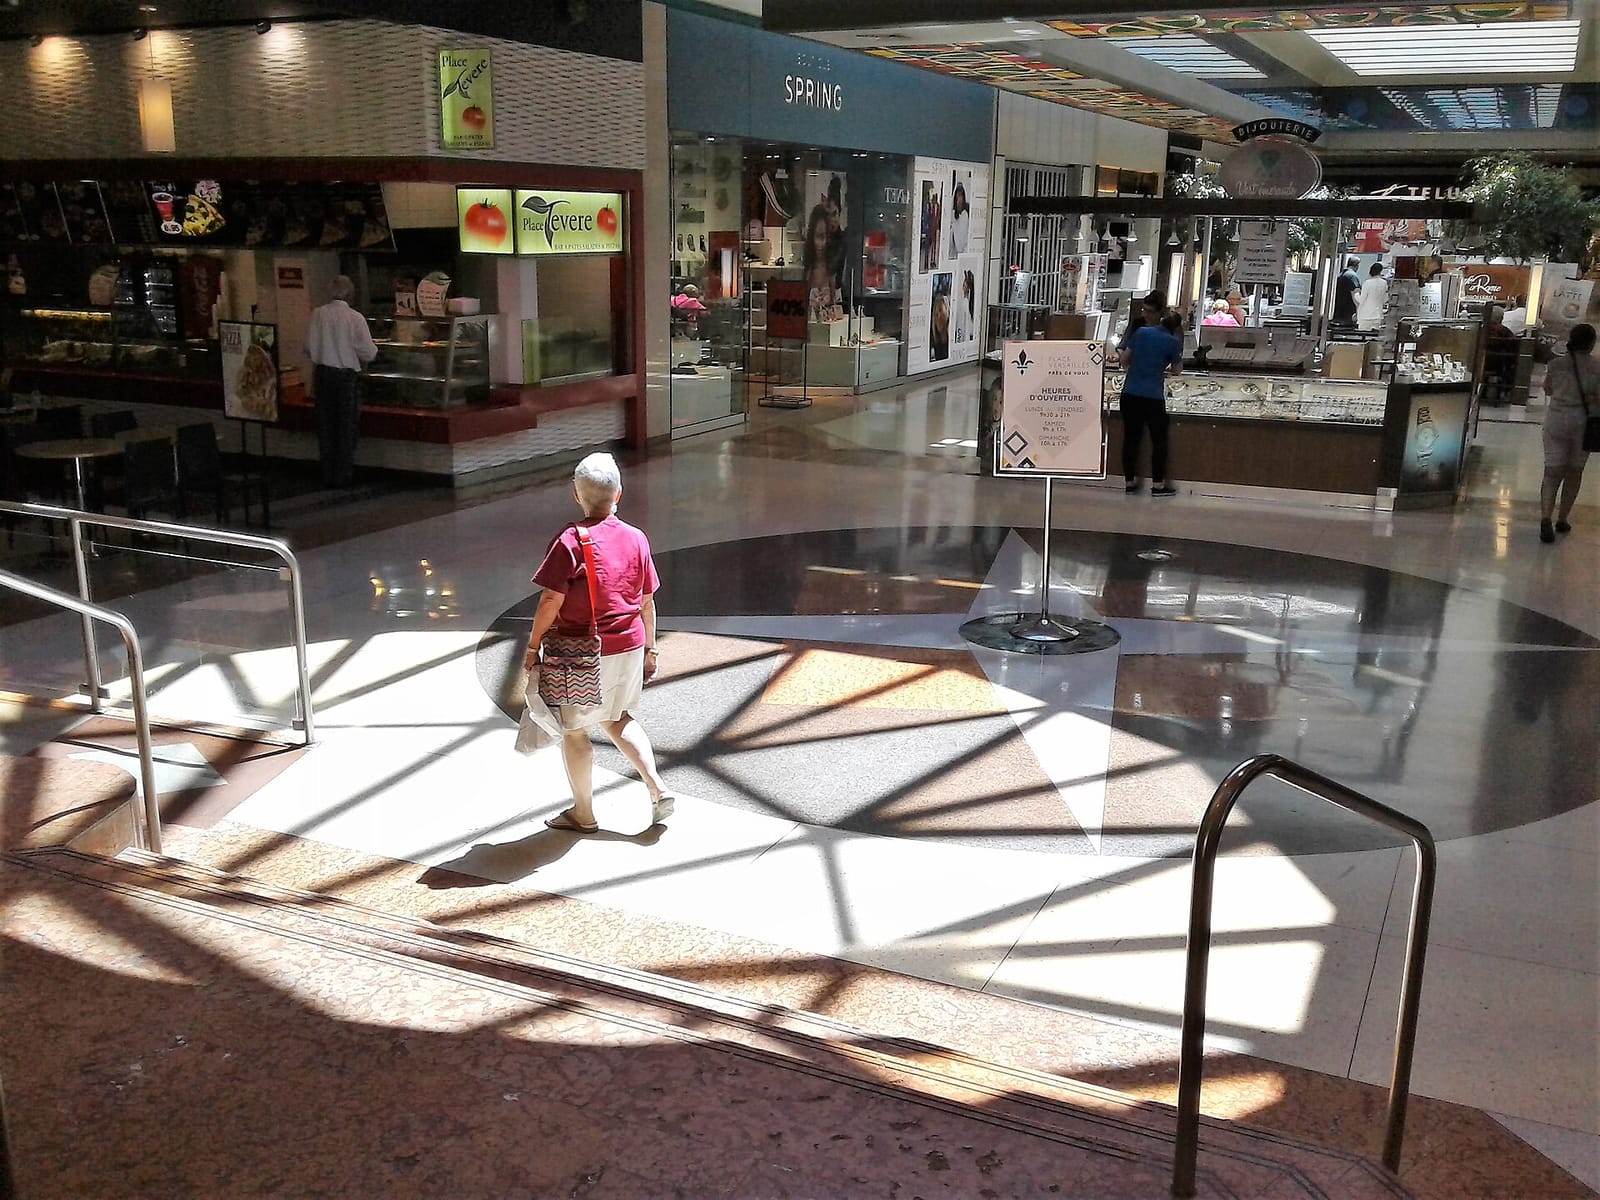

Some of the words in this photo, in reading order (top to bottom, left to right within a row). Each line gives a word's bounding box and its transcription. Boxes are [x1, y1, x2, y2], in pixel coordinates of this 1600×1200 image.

[442, 56, 467, 67] Place
[785, 75, 842, 111] SPRING
[1238, 121, 1313, 138] BIJOUTERIE
[1407, 186, 1462, 200] TELU
[523, 218, 544, 231] Place
[528, 196, 592, 249] Tevere
